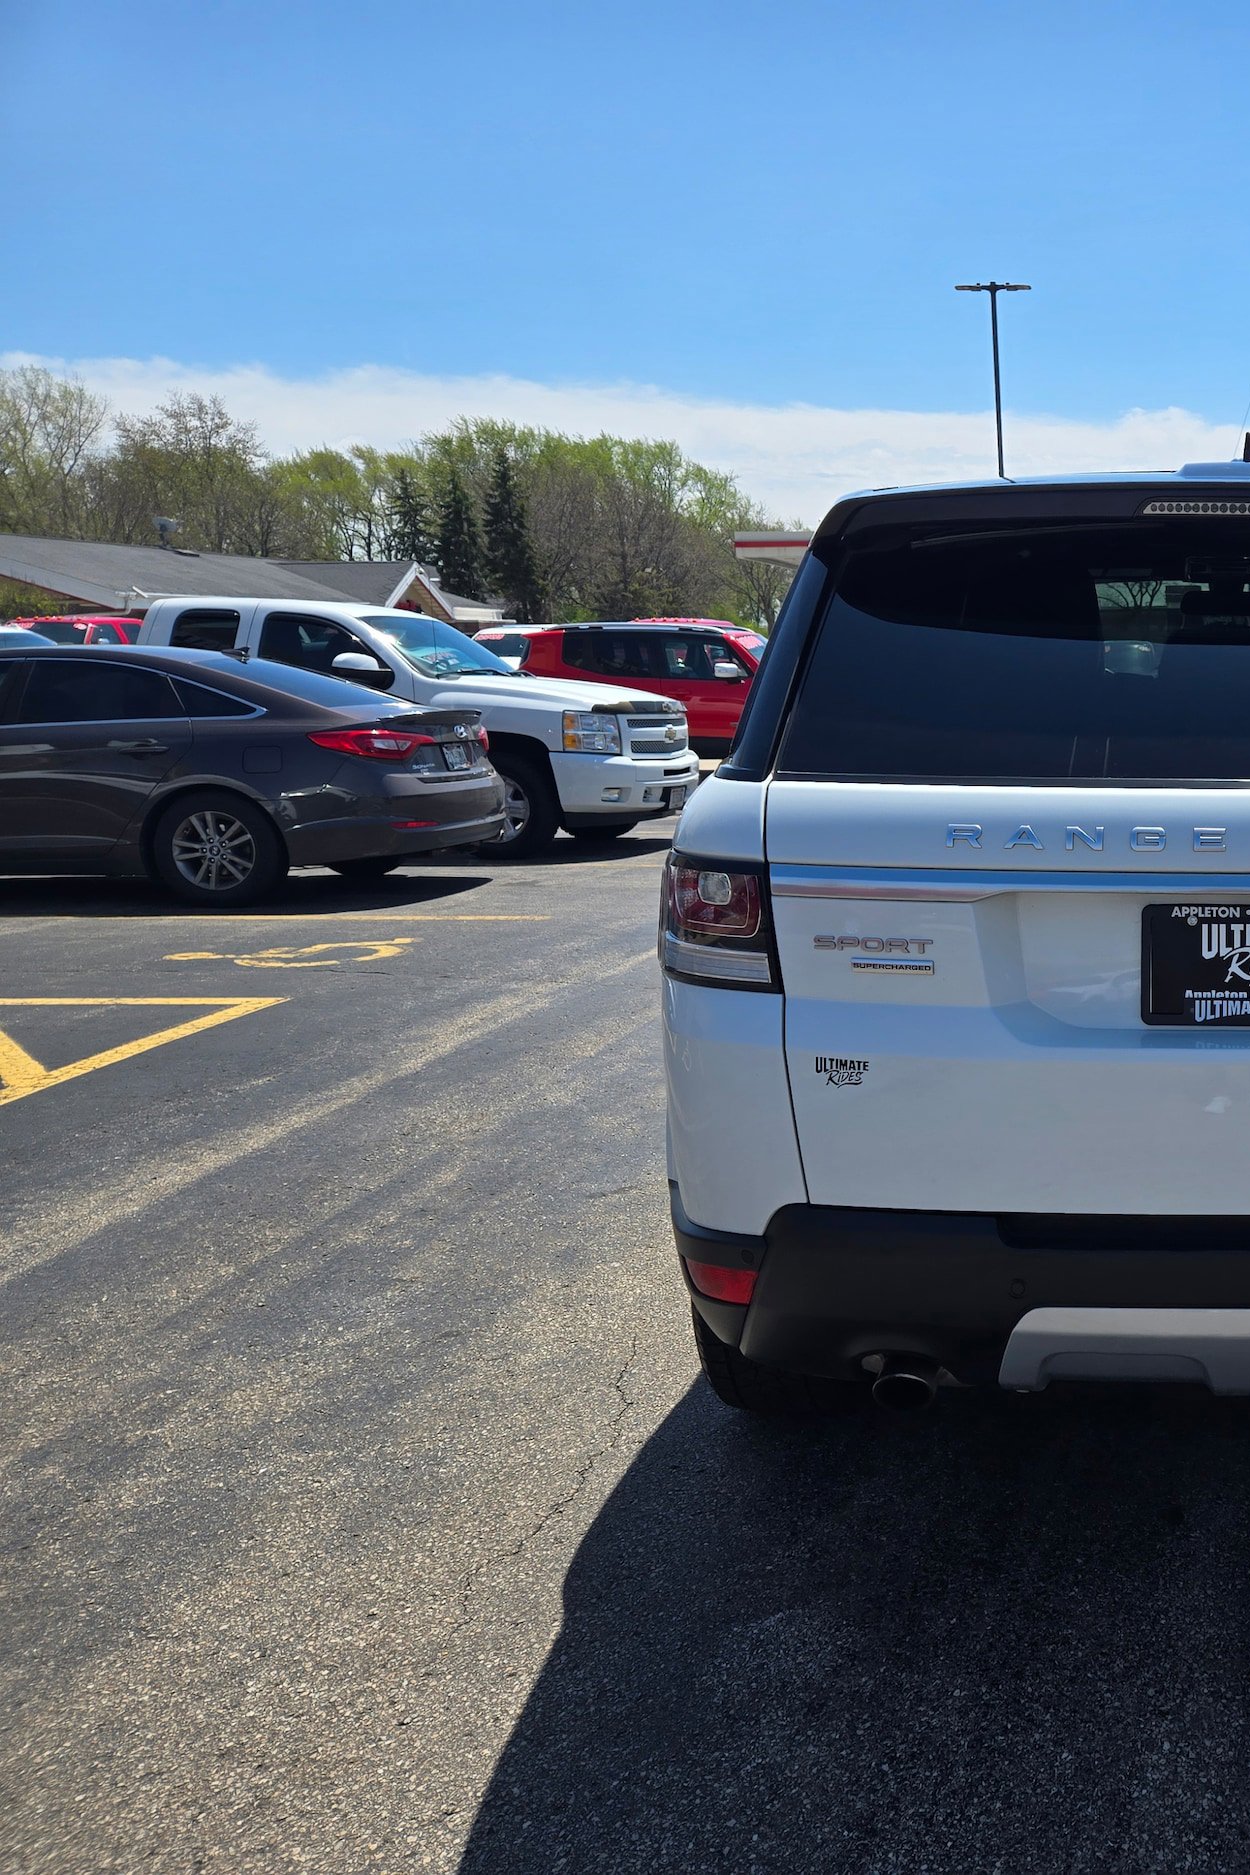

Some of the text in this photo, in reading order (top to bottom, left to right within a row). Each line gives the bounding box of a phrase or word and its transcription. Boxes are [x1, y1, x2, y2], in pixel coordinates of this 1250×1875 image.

[945, 823, 1228, 852] RANGE
[1171, 907, 1240, 918] APPLETON
[813, 934, 934, 954] SPORT
[852, 962, 931, 971] SUPERCHARGED
[815, 1056, 869, 1073] ULTIMATE
